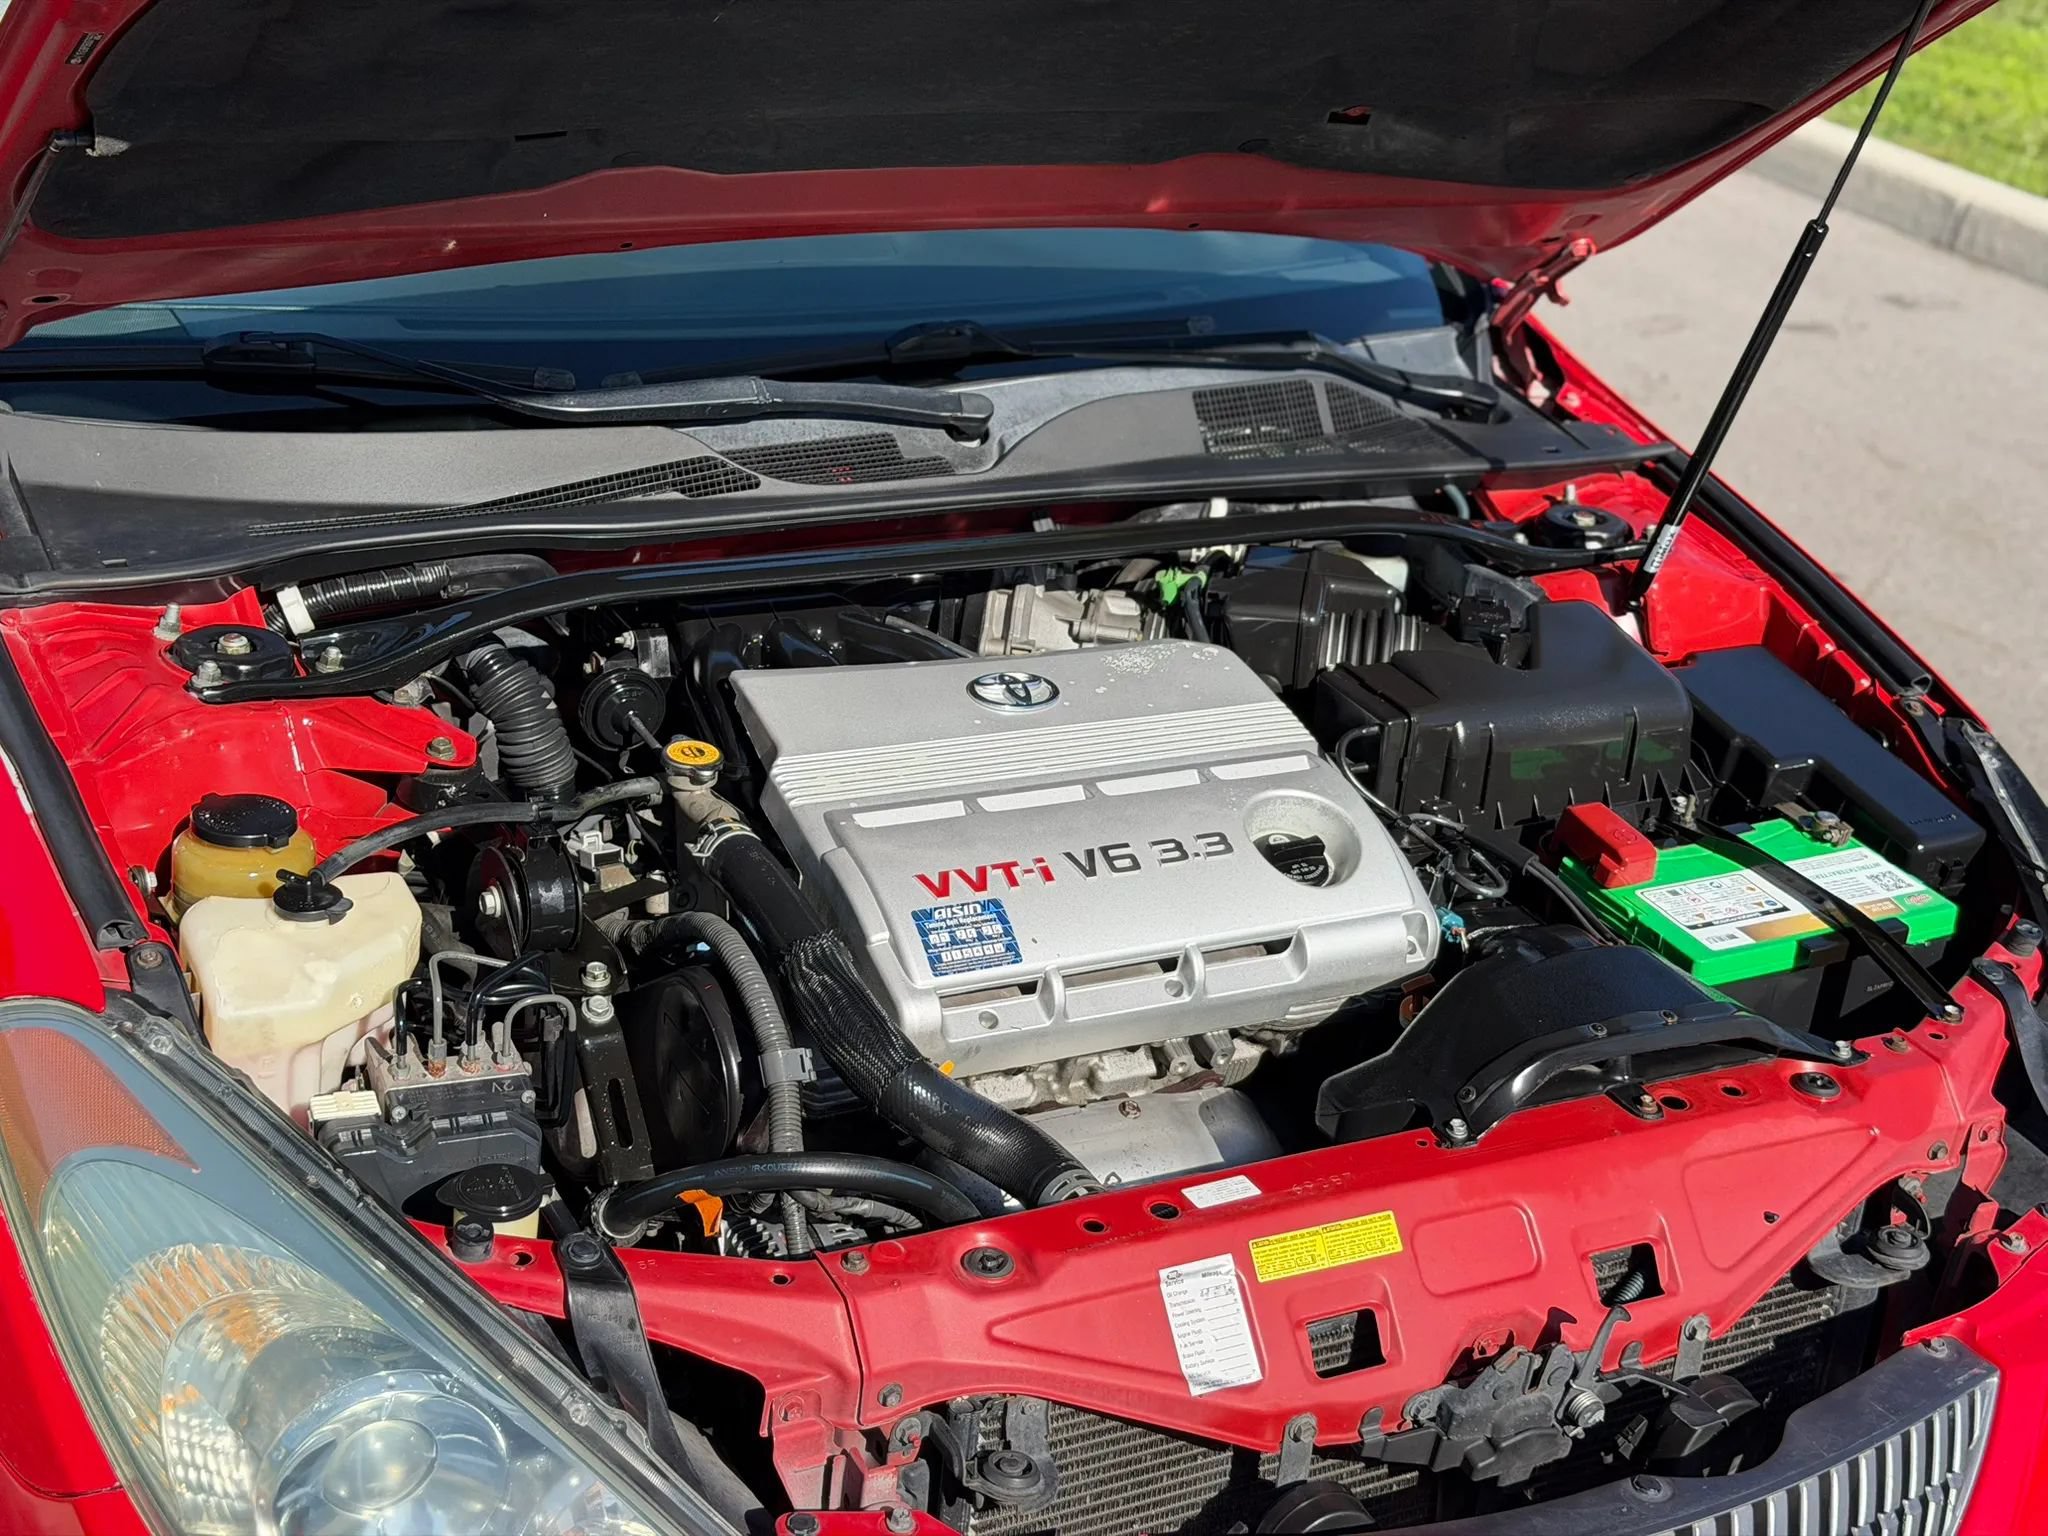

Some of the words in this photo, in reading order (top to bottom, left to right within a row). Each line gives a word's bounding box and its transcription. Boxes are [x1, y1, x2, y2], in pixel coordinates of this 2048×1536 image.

[912, 856, 1056, 900] VVT-i
[1061, 842, 1141, 881] V6
[1148, 831, 1234, 868] 3.3
